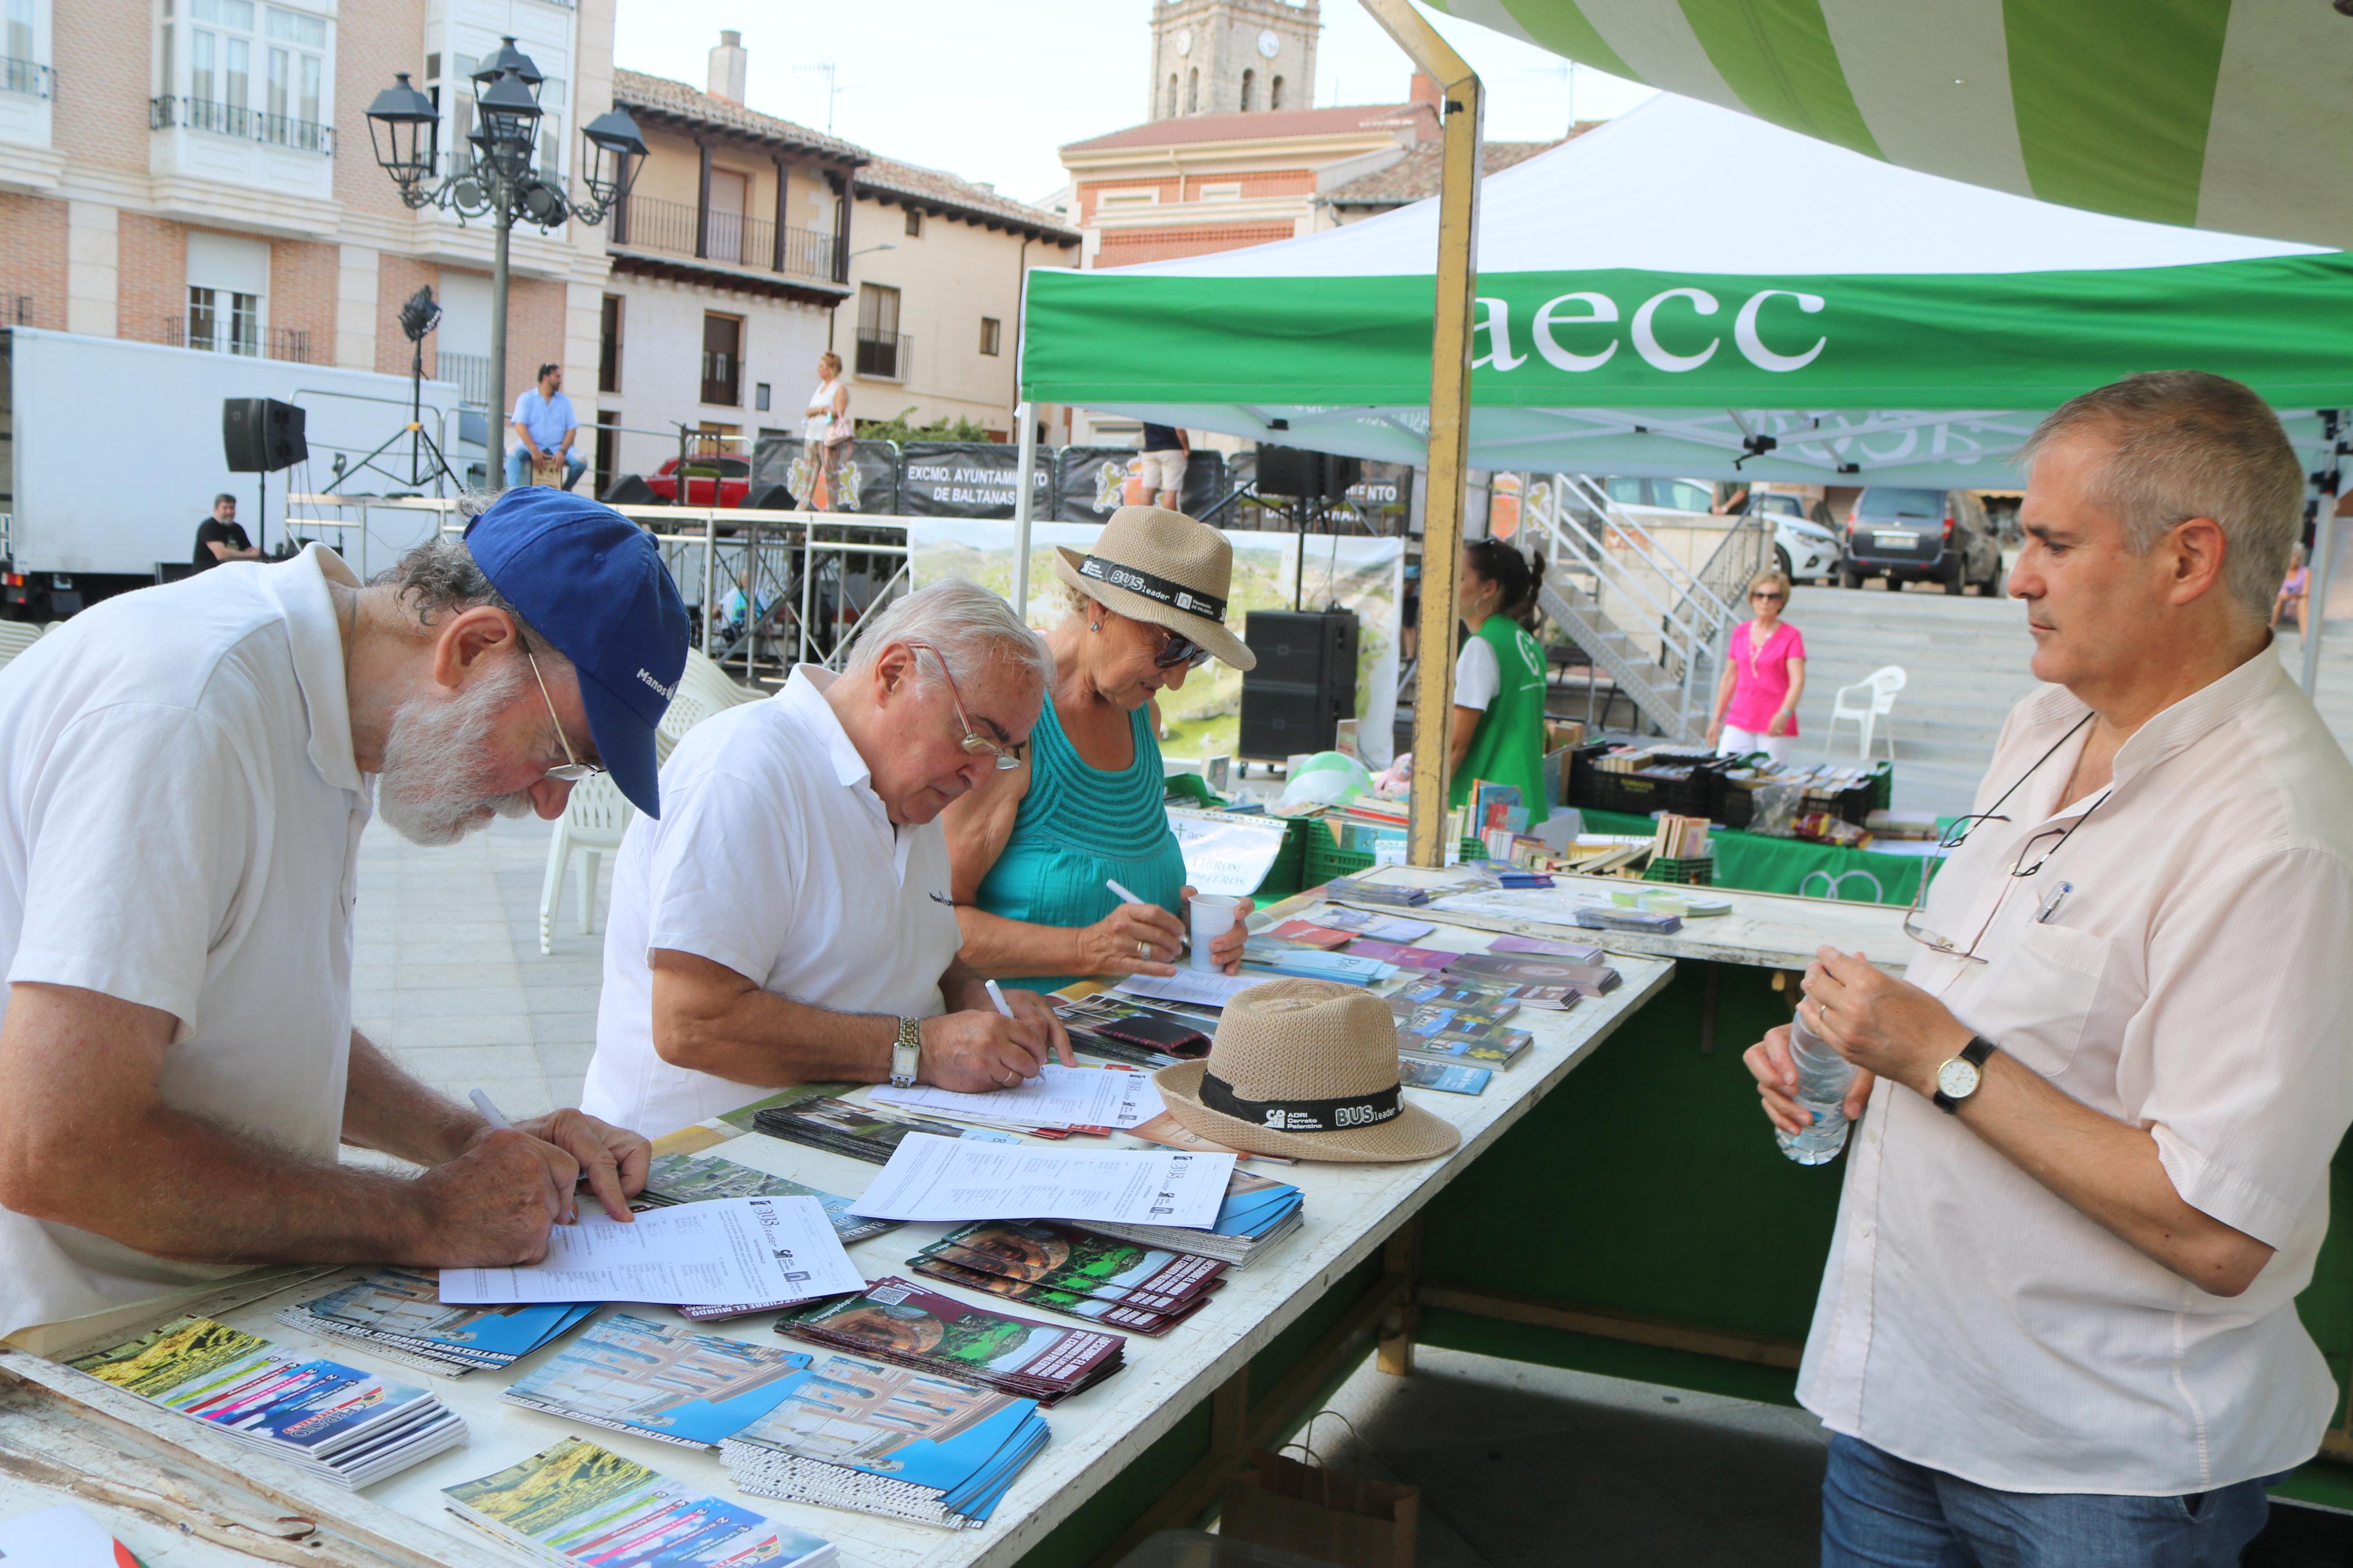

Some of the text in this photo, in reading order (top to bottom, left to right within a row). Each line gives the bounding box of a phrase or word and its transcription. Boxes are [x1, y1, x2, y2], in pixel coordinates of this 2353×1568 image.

[1471, 287, 1826, 372] aecc
[907, 465, 1048, 487] EXCMO. AYUNTAMITO
[933, 486, 1016, 505] DE BALTANAS
[1110, 570, 1171, 602] BUS leader
[636, 668, 667, 696] Manos
[1335, 1105, 1396, 1127] BUS leader
[753, 1206, 780, 1247] BUS leader
[690, 1306, 732, 1316] MUNDO
[307, 1315, 517, 1362] MUSEO DEL CERRATO CASTELLANO
[289, 1401, 367, 1438] CERRATO
[542, 1404, 567, 1416] DEL
[565, 1410, 627, 1431] CERRATO
[624, 1425, 712, 1450] CASTELLANO
[716, 1437, 946, 1499] MUSEO DEL CERRATO CASTELLANO
